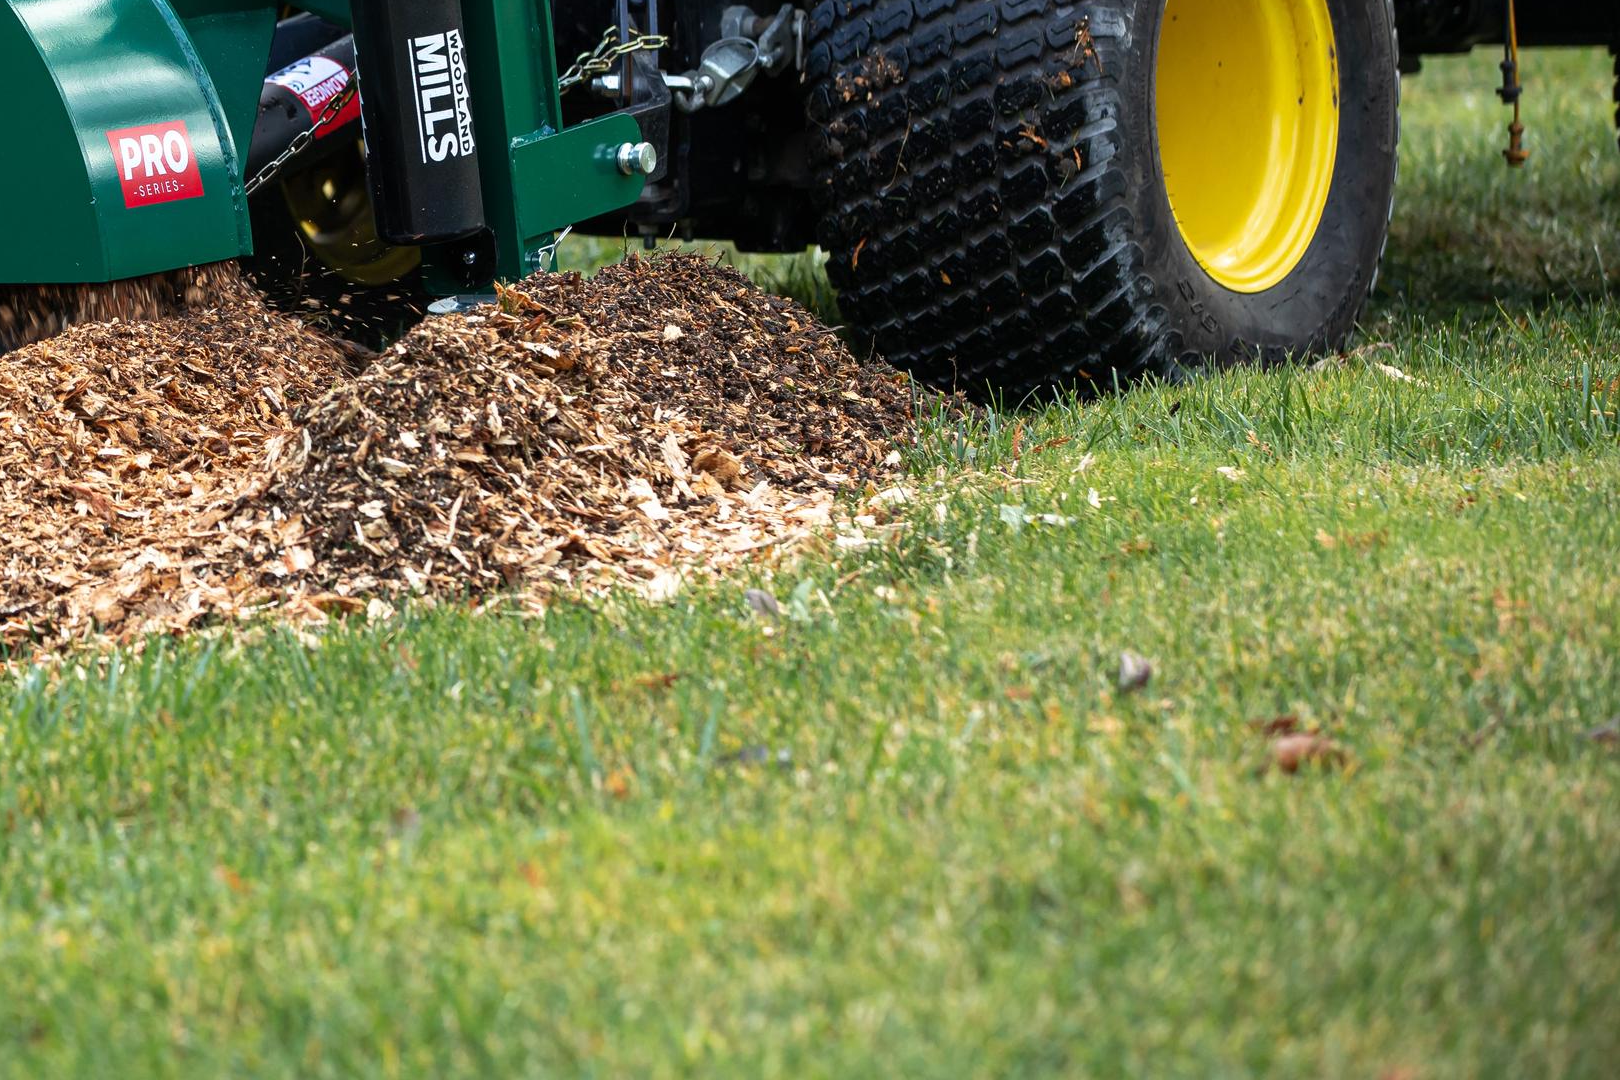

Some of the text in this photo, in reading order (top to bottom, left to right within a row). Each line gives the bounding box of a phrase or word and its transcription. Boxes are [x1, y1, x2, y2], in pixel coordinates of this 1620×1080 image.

[301, 74, 342, 108] DANGER
[414, 33, 459, 162] MILLS
[449, 33, 471, 153] WOODLAND
[119, 129, 189, 181] PRO
